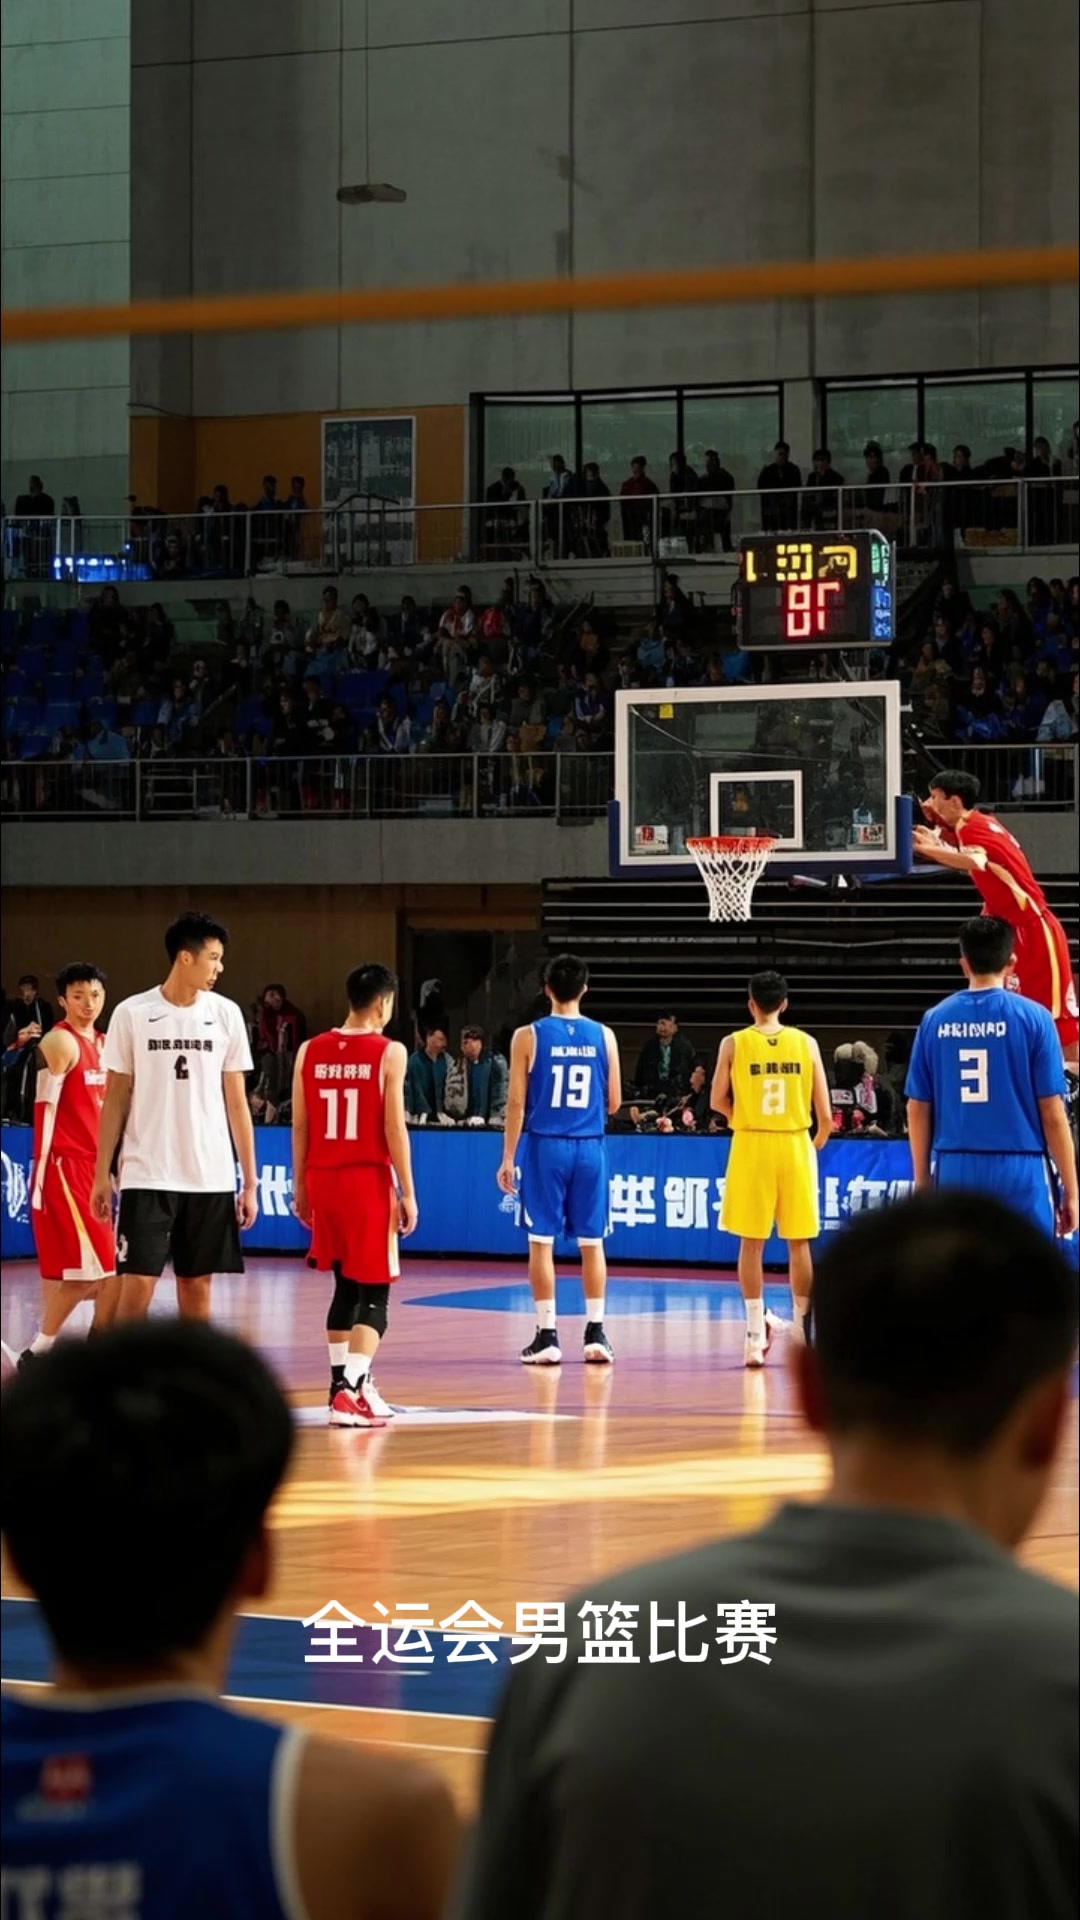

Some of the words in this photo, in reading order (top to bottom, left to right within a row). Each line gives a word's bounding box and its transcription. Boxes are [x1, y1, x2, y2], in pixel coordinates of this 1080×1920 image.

[551, 1064, 592, 1109] 19
[959, 1049, 989, 1103] 3
[319, 1088, 359, 1140] 11
